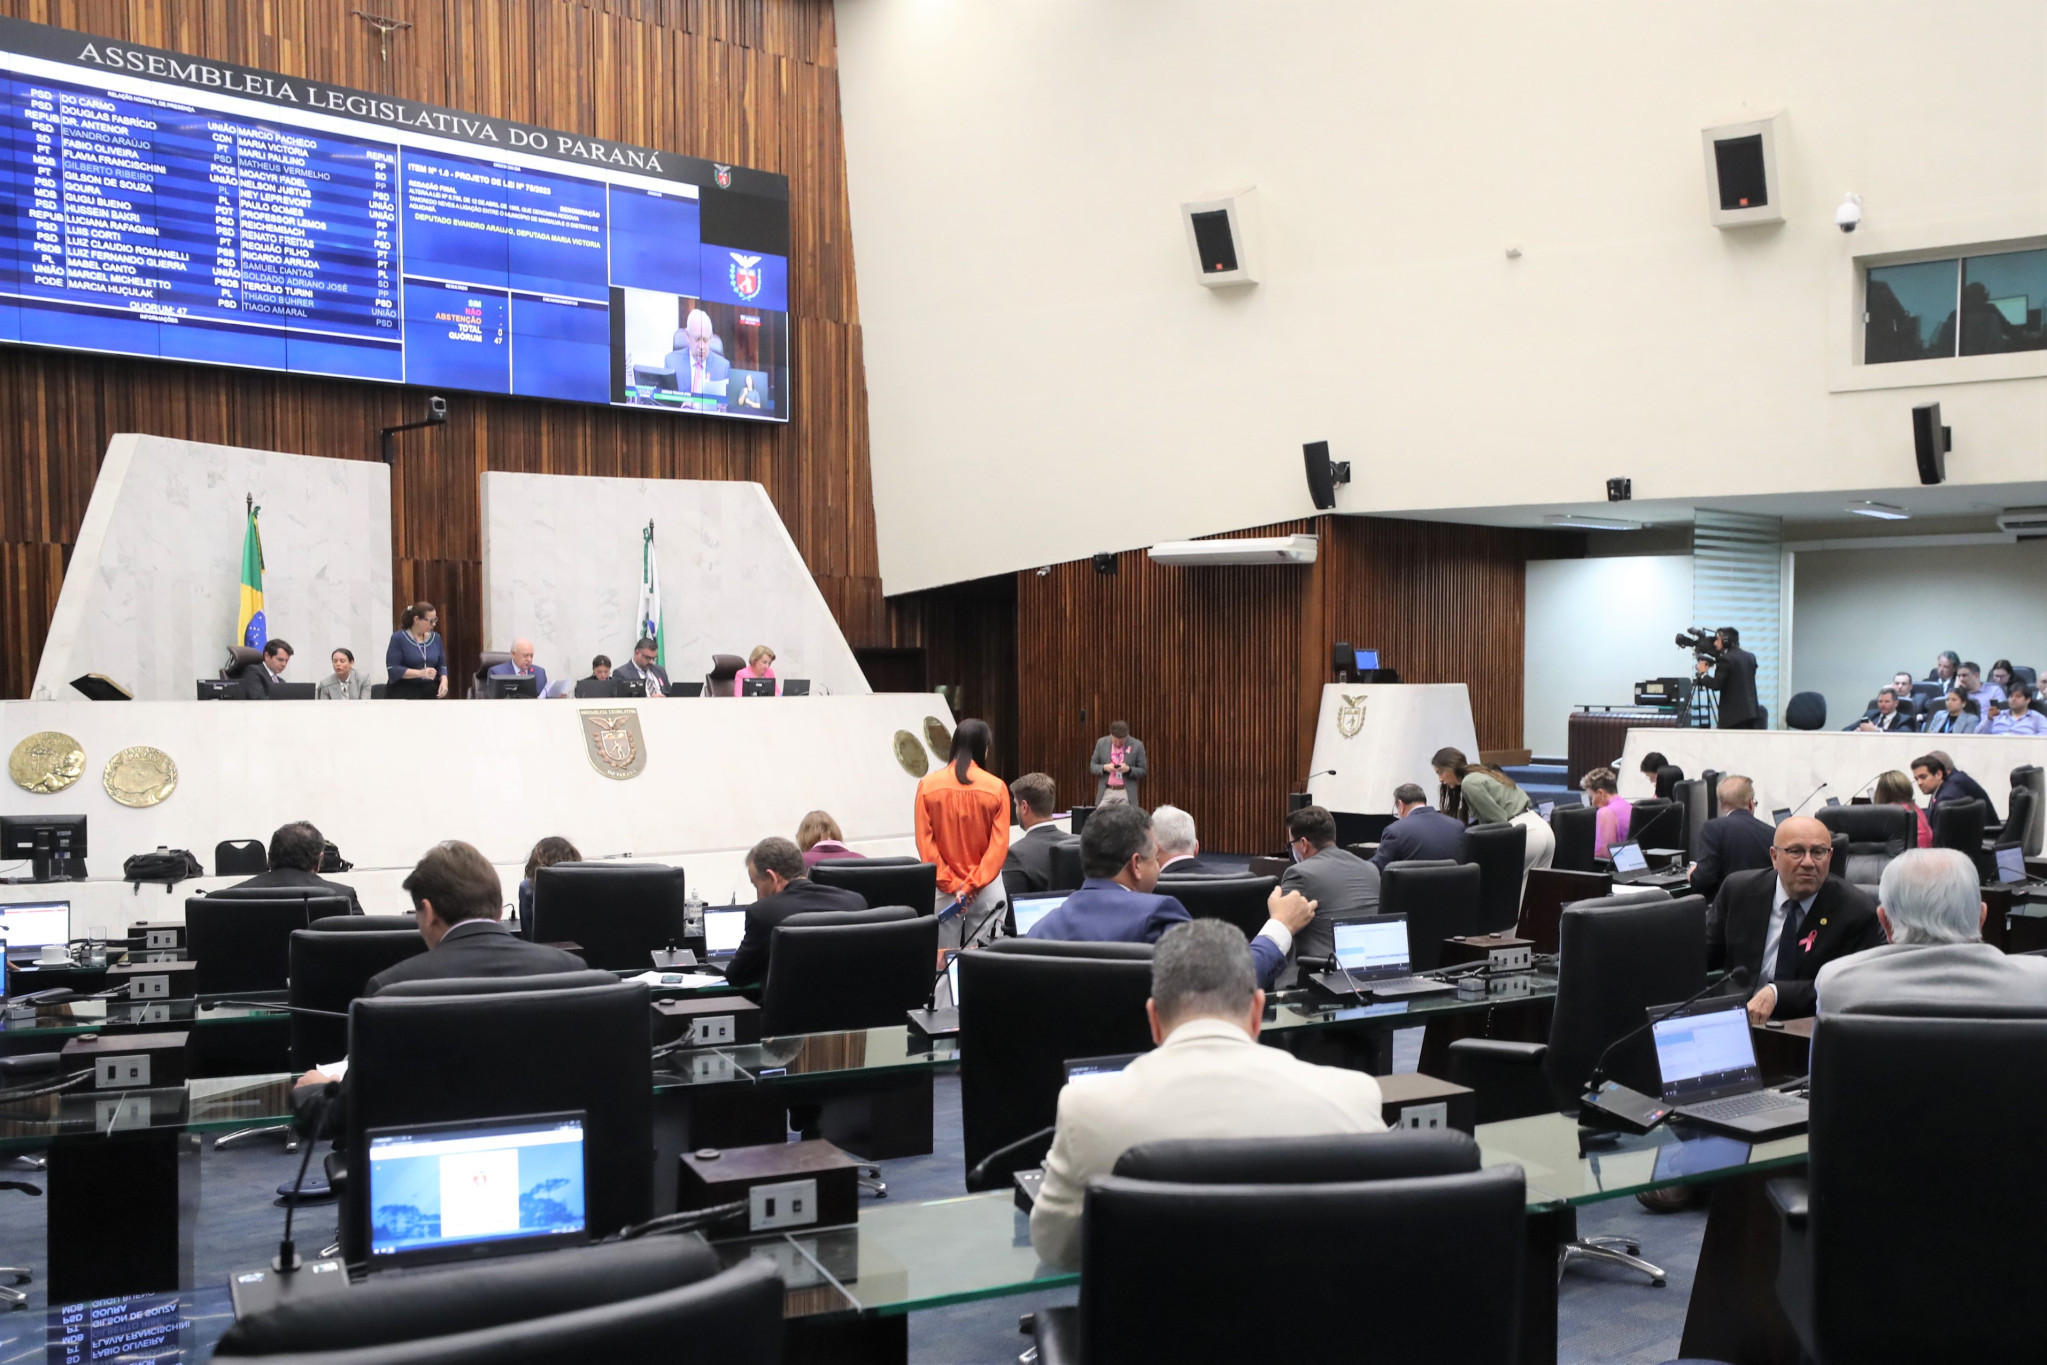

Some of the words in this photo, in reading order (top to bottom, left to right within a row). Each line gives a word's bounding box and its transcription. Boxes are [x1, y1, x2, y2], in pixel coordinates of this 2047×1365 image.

[30, 88, 52, 100] PSD
[31, 100, 52, 111] PSD
[61, 94, 76, 105] DO
[78, 97, 115, 112] CARMO
[78, 43, 299, 102] ASSEMBLEIA
[307, 87, 499, 142] LEGISLATIVA
[508, 127, 548, 149] DO
[557, 136, 663, 173] PARANÁ
[24, 109, 59, 123] REPUB
[61, 105, 110, 121] DOUGLAS
[32, 122, 53, 133] PSD
[62, 116, 79, 127] DR.
[81, 119, 128, 135] ANTENOR
[207, 119, 236, 134] UNIÃO
[36, 133, 51, 144] SD
[62, 127, 110, 143] EVANDRO
[212, 132, 232, 143] CDN
[275, 134, 317, 148] PACHECO
[37, 144, 51, 154] PT
[63, 138, 92, 150] FABIO
[94, 143, 139, 158] OLIVEIRA
[216, 143, 228, 153] PT
[238, 137, 266, 149] MARIA
[267, 142, 309, 157] VICTORIA
[32, 154, 56, 166] MDB
[63, 149, 97, 162] FLAVIA
[98, 155, 166, 173] FRANCISCHINI
[213, 153, 232, 164] PSD
[267, 152, 305, 166] PAULINO
[366, 150, 394, 162] REPUB
[38, 166, 52, 176] PT
[64, 160, 112, 175] GILBERTO
[115, 168, 153, 182] RIBEIRO
[210, 163, 236, 175] PODE
[239, 158, 281, 172] MATHEUS
[283, 165, 330, 181] VERMELHO
[374, 162, 386, 171] PP
[64, 171, 101, 184] GILSON
[103, 177, 117, 187] DE
[119, 179, 152, 192] SOUZA
[209, 171, 238, 185] UNIÃO
[239, 168, 278, 182] MOACYR
[279, 175, 307, 187] FADEL
[375, 172, 386, 180] SD
[454, 171, 489, 184] PROJETO
[490, 177, 501, 186] DE
[503, 179, 514, 188] LEI
[34, 177, 56, 188] PSD
[65, 182, 101, 195] GOURA
[240, 178, 275, 191] NELSON
[277, 185, 311, 197] JUSTUS
[34, 188, 57, 199] MDB
[218, 185, 229, 194] PL
[65, 192, 94, 204] GUGU
[96, 197, 131, 210] BUENO
[218, 195, 230, 204] PL
[240, 189, 258, 199] NEY
[260, 192, 312, 207] LEPREVOST
[35, 199, 57, 210] PSD
[215, 205, 233, 215] PDT
[240, 199, 269, 211] PAULO
[271, 204, 304, 216] GOMES
[29, 209, 63, 222] REPUB
[66, 203, 109, 217] HUSSEIN
[111, 210, 140, 222] BAKRI
[66, 214, 109, 228] LUCIANA
[110, 221, 158, 235] RAFAGNIN
[215, 216, 234, 226] PSD
[241, 209, 295, 225] PROFESSOR
[297, 218, 326, 230] LEMOS
[36, 221, 58, 232] PSD
[66, 225, 91, 236] LUIS
[93, 229, 120, 240] CORTI
[216, 226, 235, 236] PSD
[415, 212, 452, 225] DEPUTADO
[453, 218, 484, 230] EVANDRO
[516, 228, 550, 241] DEPUTADA
[572, 238, 600, 249] VICTORIA
[37, 232, 58, 243] PSD
[219, 237, 231, 246] PT
[241, 230, 277, 242] RENATO
[279, 235, 314, 248] FREITAS
[34, 243, 62, 254] PSDB
[67, 236, 88, 247] LUIZ
[90, 240, 133, 253] CLAUDIO
[135, 246, 189, 260] ROMANELLI
[216, 247, 235, 256] PSB
[284, 246, 309, 257] FILHO
[42, 255, 54, 264] PL
[67, 247, 89, 258] LUIZ
[91, 250, 144, 265] FERNANDO
[146, 258, 186, 271] GUERRA
[217, 257, 236, 267] PSD
[242, 250, 282, 263] RICARDO
[283, 256, 320, 268] ARRUDA
[32, 262, 64, 276] UNIÃO
[67, 258, 100, 270] MABEL
[102, 263, 136, 275] CANTO
[212, 265, 241, 278] UNIÃO
[242, 261, 278, 273] SAMUEL
[280, 266, 313, 278] DANTAS
[35, 276, 63, 287] PODE
[68, 269, 108, 282] MARCEL
[110, 274, 171, 290] MICHELETTO
[214, 278, 239, 288] PSDB
[243, 271, 284, 284] SOLDADO
[286, 277, 324, 289] ADRIANO
[68, 280, 106, 292] MARCIA
[221, 289, 233, 298] PL
[243, 292, 276, 303] THIAGO
[285, 287, 313, 298] TURINI
[218, 299, 237, 308] PSD
[243, 302, 270, 312] TIAGO
[272, 306, 307, 317] AMARAL
[468, 299, 482, 308] SIM
[176, 306, 187, 314] 47
[465, 306, 482, 316] NÃO
[435, 311, 482, 325] ABSTENÇÃO
[458, 323, 481, 333] TOTAL
[494, 336, 502, 344] 47
